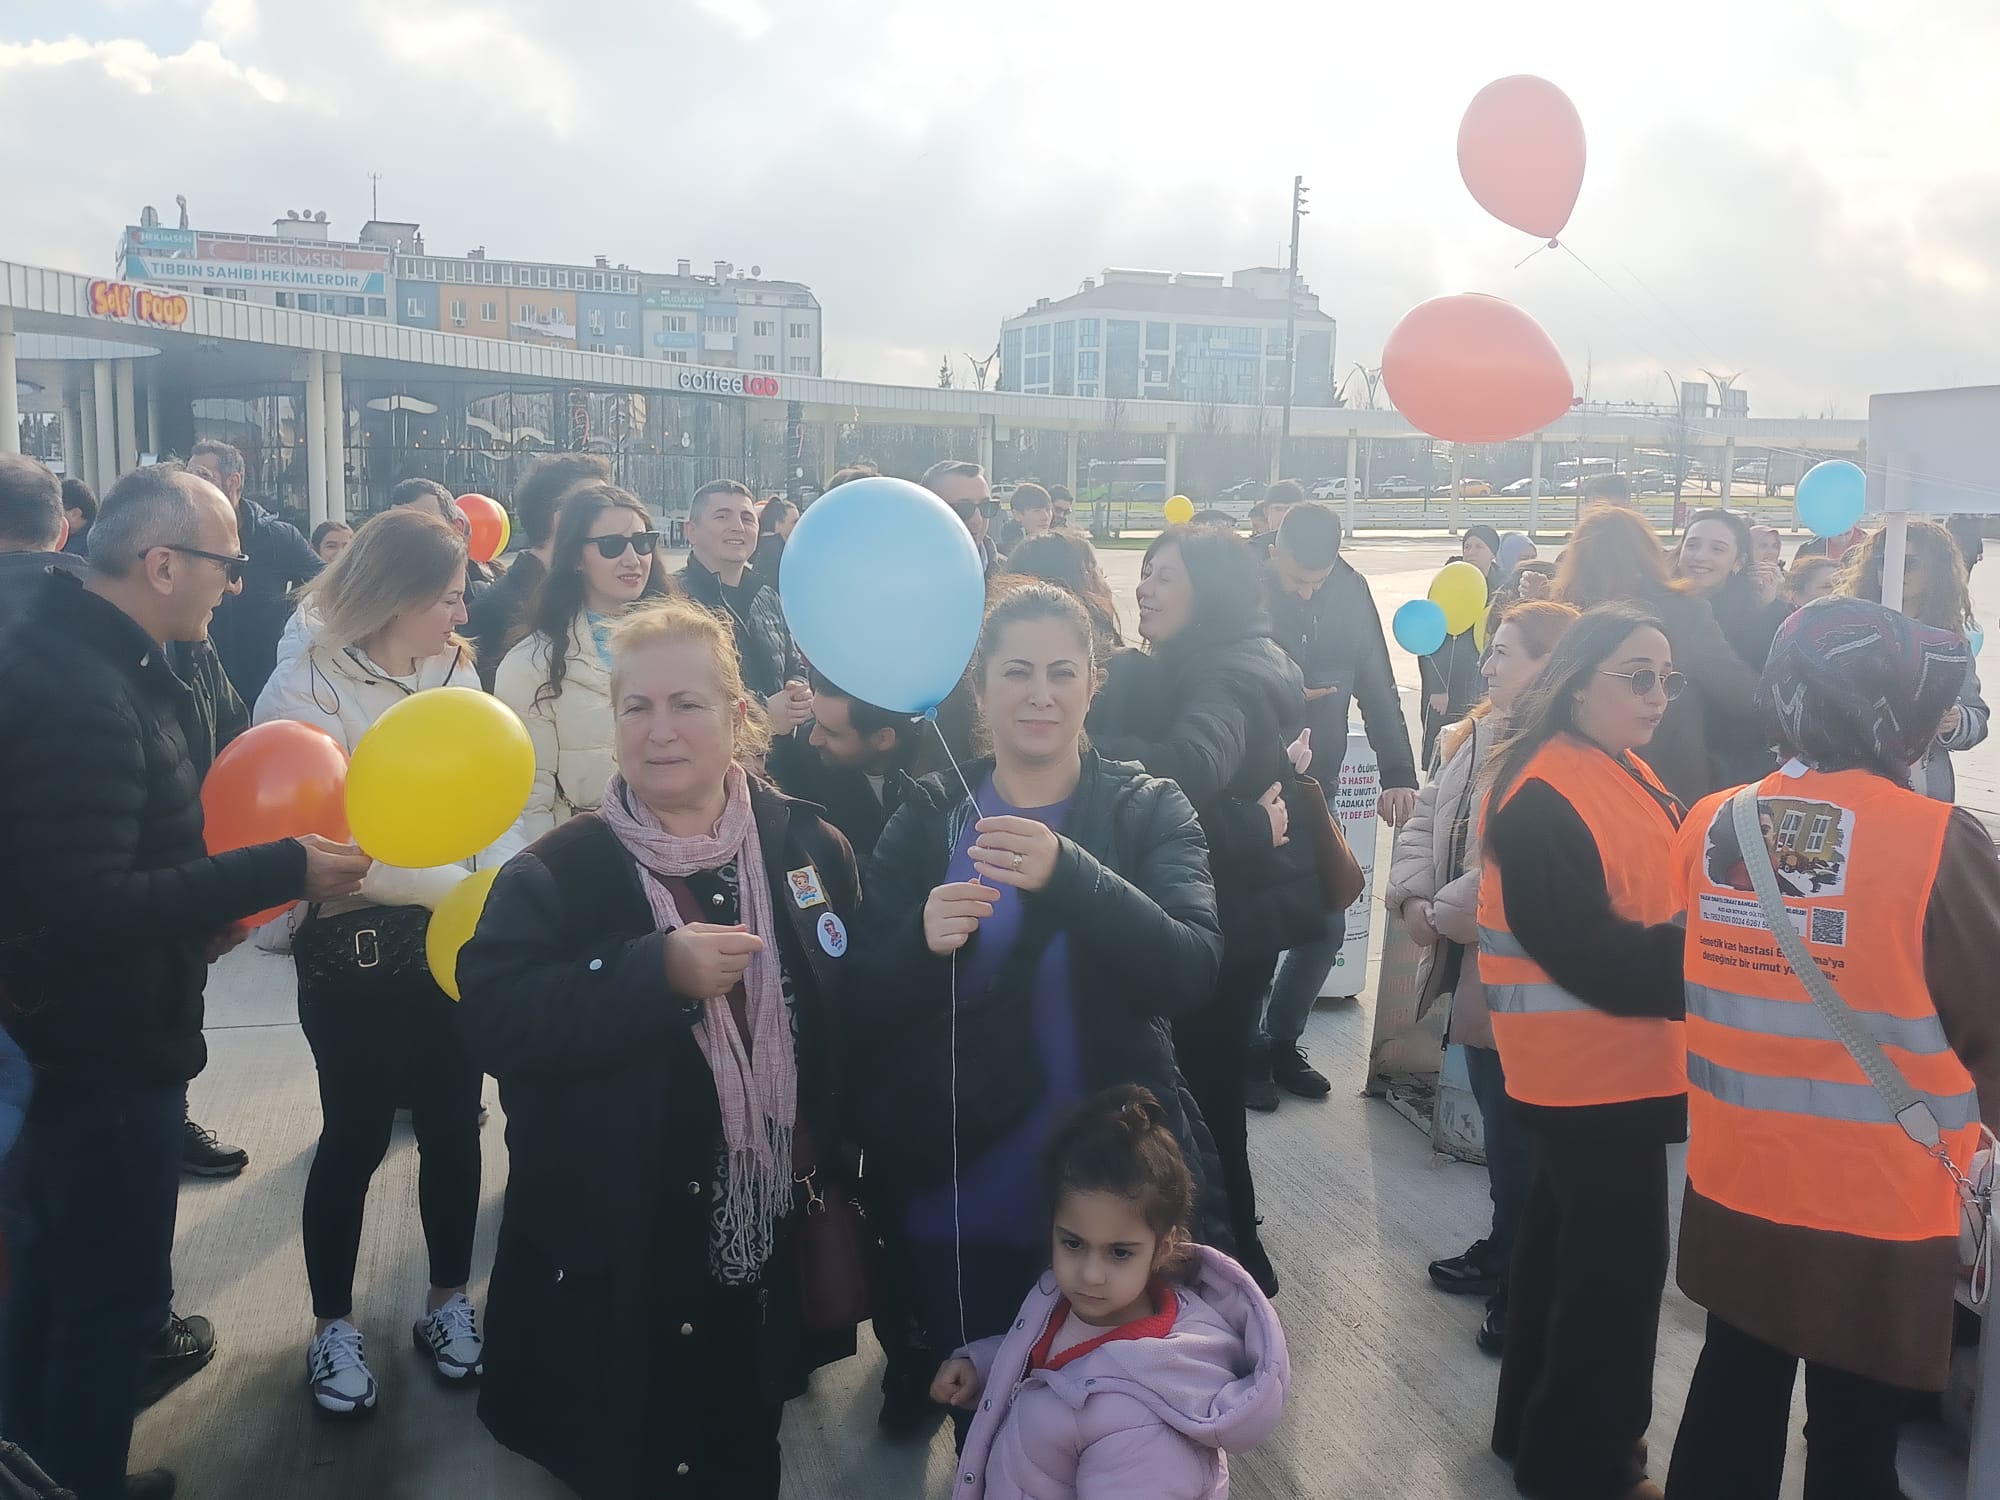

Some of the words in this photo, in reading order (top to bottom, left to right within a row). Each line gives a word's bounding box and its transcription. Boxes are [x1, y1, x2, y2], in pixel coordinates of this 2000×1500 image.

[255, 246, 344, 268] HEKİMSEN
[151, 262, 203, 277] TIBBIN
[206, 264, 257, 281] SAHİBİ
[261, 267, 359, 288] HEKİMLERDİR
[1349, 811, 1362, 819] DEF
[1739, 957, 1750, 969] bir
[1752, 962, 1781, 974] umut
